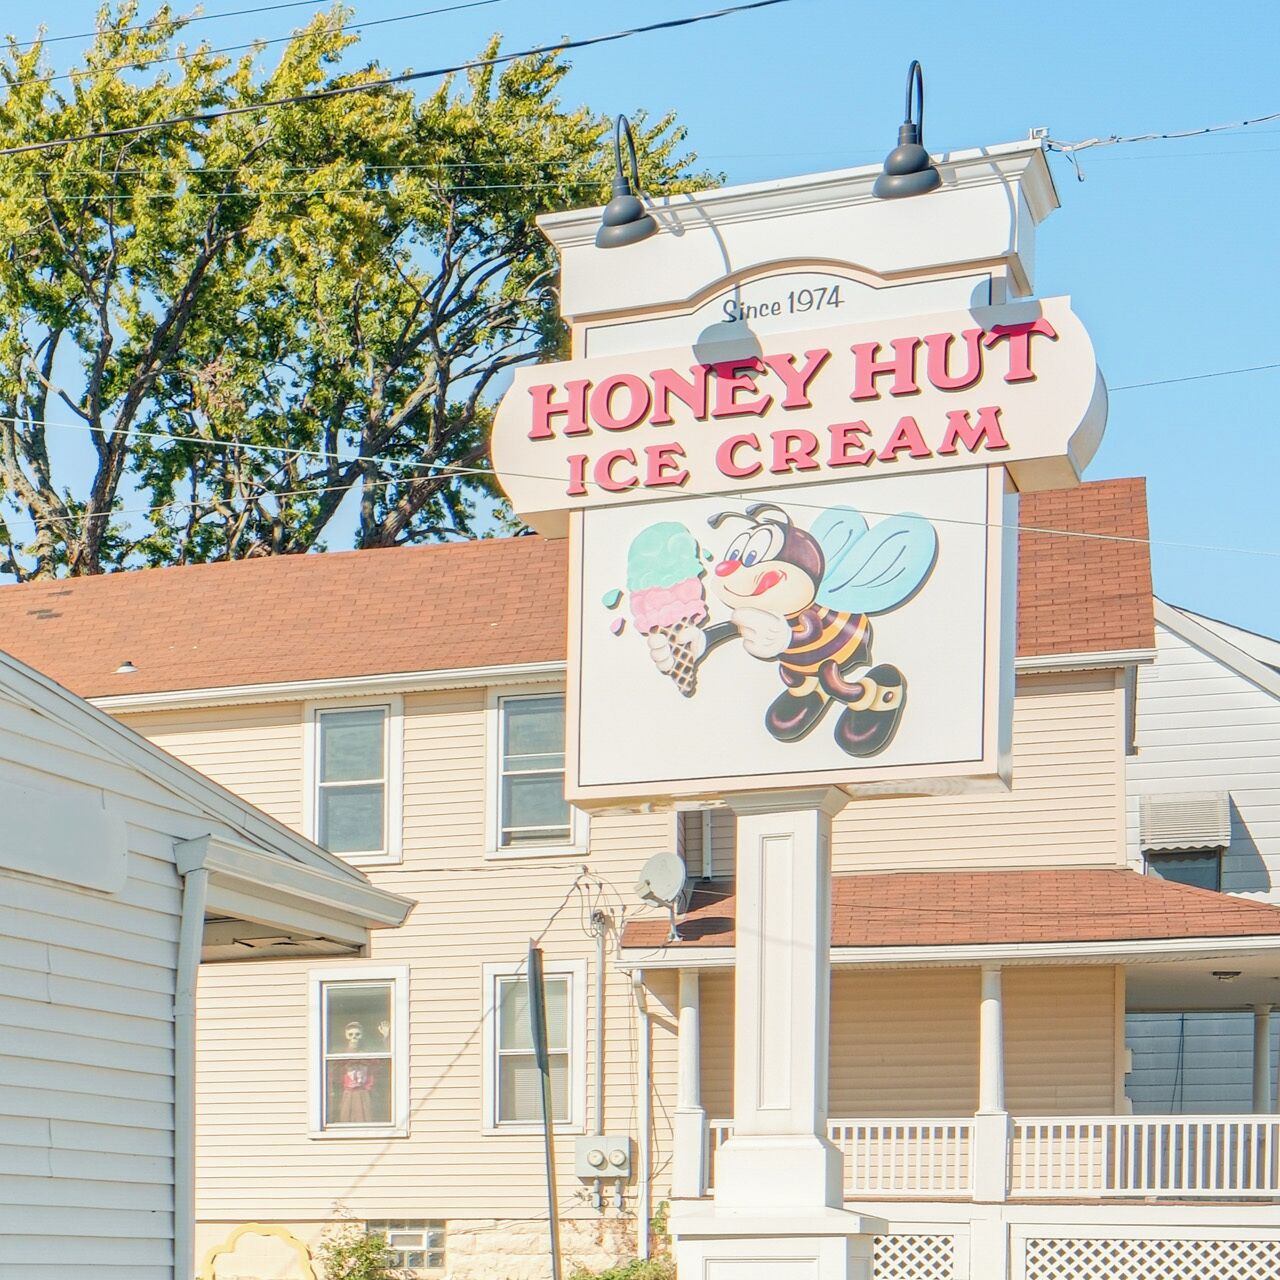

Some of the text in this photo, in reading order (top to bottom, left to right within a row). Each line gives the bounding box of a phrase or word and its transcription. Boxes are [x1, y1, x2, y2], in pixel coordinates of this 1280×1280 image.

[722, 285, 844, 322] Since 1974
[528, 318, 1058, 439] HONEY HUT
[567, 406, 1009, 496] ICE CREAM
